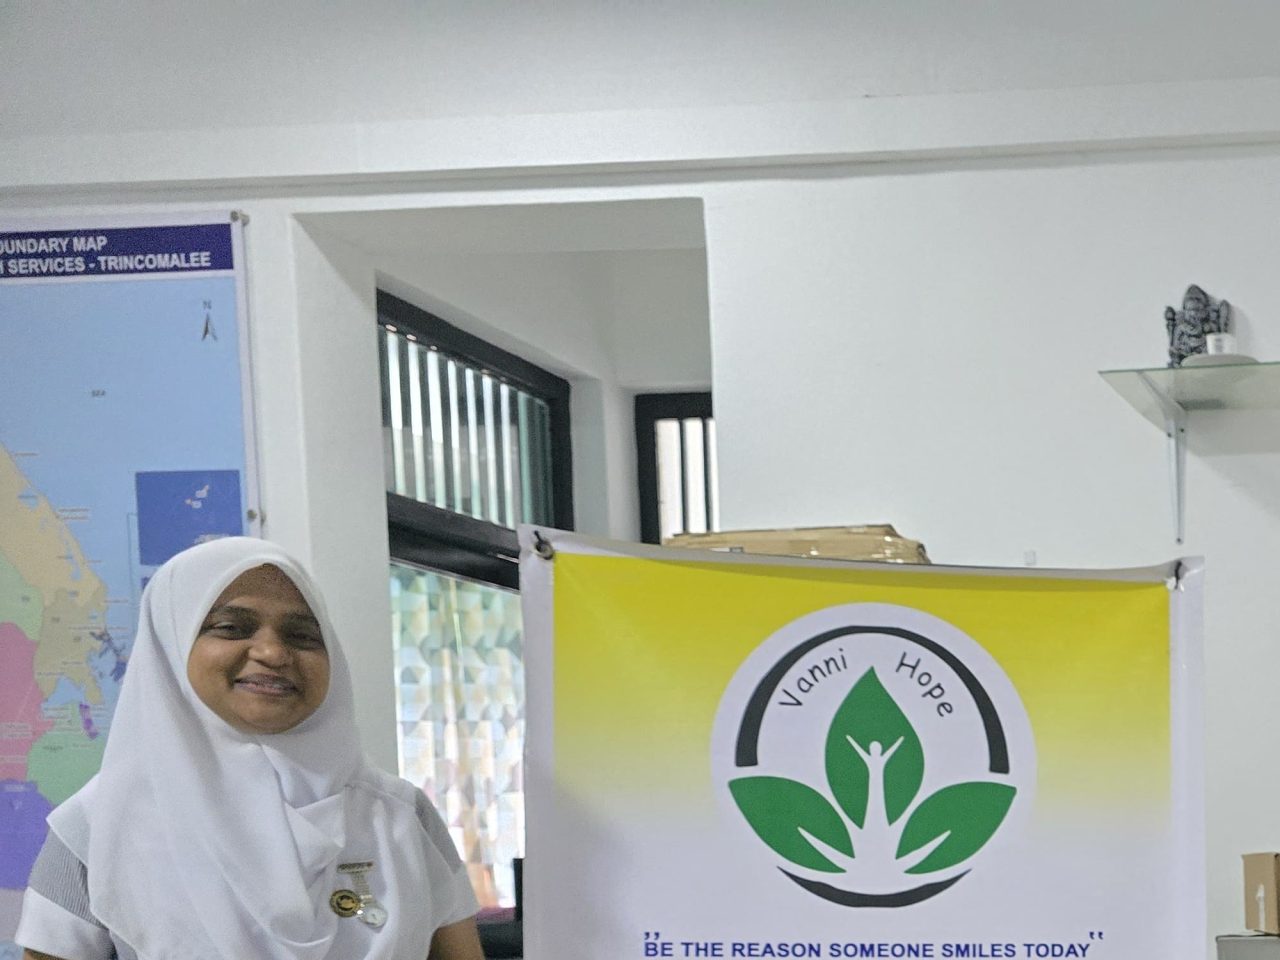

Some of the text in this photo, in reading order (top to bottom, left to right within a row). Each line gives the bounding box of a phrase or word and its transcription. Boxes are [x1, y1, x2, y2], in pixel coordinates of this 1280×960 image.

[73, 236, 108, 252] MAP
[8, 257, 85, 275] SERVICES
[99, 251, 212, 271] TRINCOMALEE
[778, 647, 954, 718] Vanni Hope
[681, 942, 723, 958] THE
[731, 942, 821, 958] REASON
[829, 942, 935, 958] SOMEONE
[942, 942, 1016, 959] SMILES
